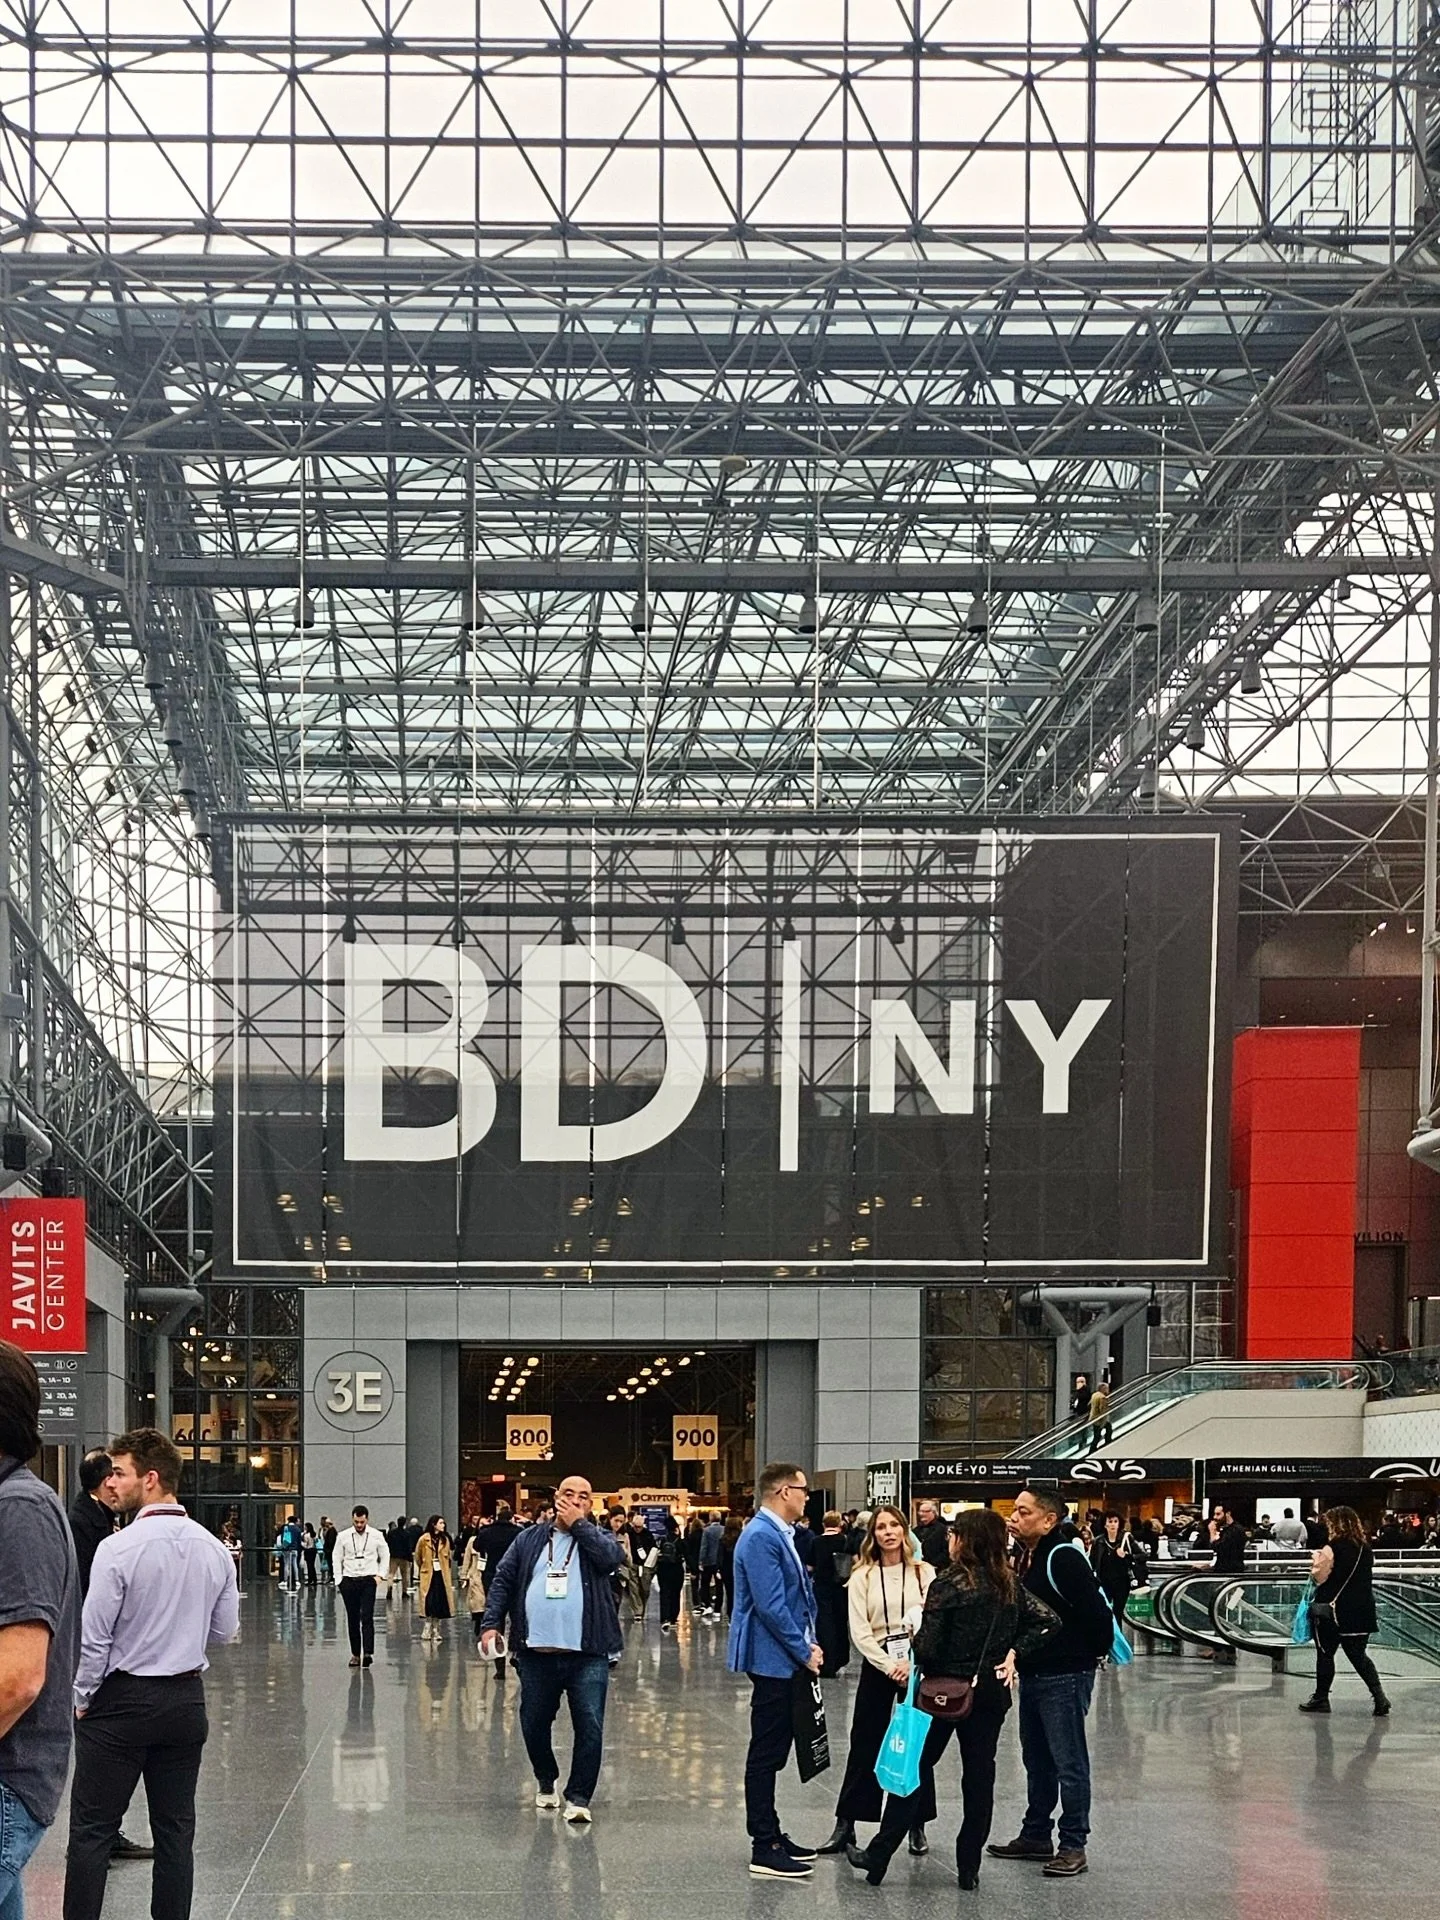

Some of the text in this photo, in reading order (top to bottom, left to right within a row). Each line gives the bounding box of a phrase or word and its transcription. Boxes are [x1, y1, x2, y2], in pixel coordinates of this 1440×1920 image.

[344, 944, 707, 1161] BD
[869, 999, 1112, 1113] NY
[1354, 1231, 1404, 1242] VILION
[11, 1221, 36, 1329] JAVITS
[46, 1221, 65, 1331] CENTER
[326, 1371, 382, 1413] 3E
[509, 1429, 549, 1446] 800
[675, 1429, 716, 1446] 900
[1220, 1465, 1268, 1473] ATHENIAN
[1270, 1465, 1297, 1473] GRILL
[640, 1493, 681, 1502] CRYPTON
